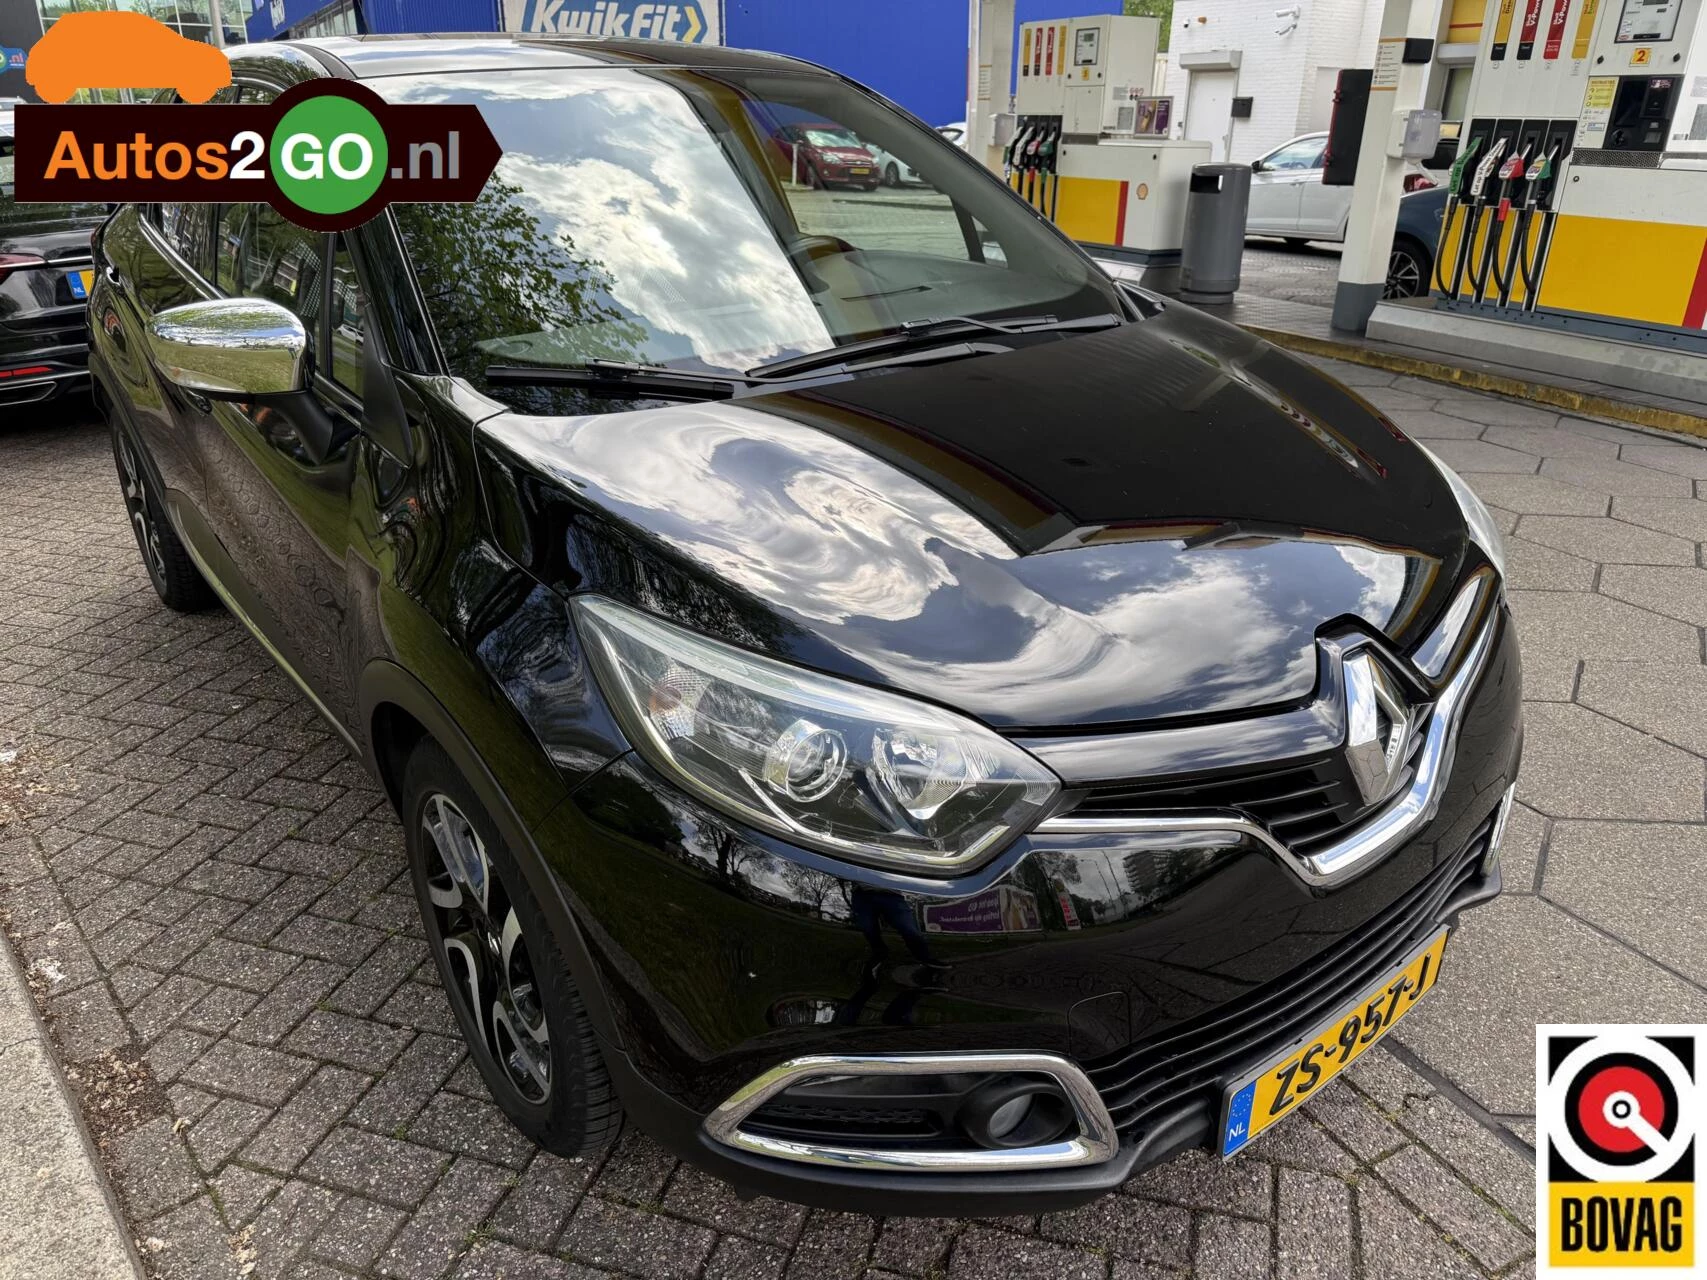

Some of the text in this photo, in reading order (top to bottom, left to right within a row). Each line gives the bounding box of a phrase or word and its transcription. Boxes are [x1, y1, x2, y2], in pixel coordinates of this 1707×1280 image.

[1636, 50, 1646, 62] 2
[1229, 952, 1432, 1142] NL ZS-957-J
